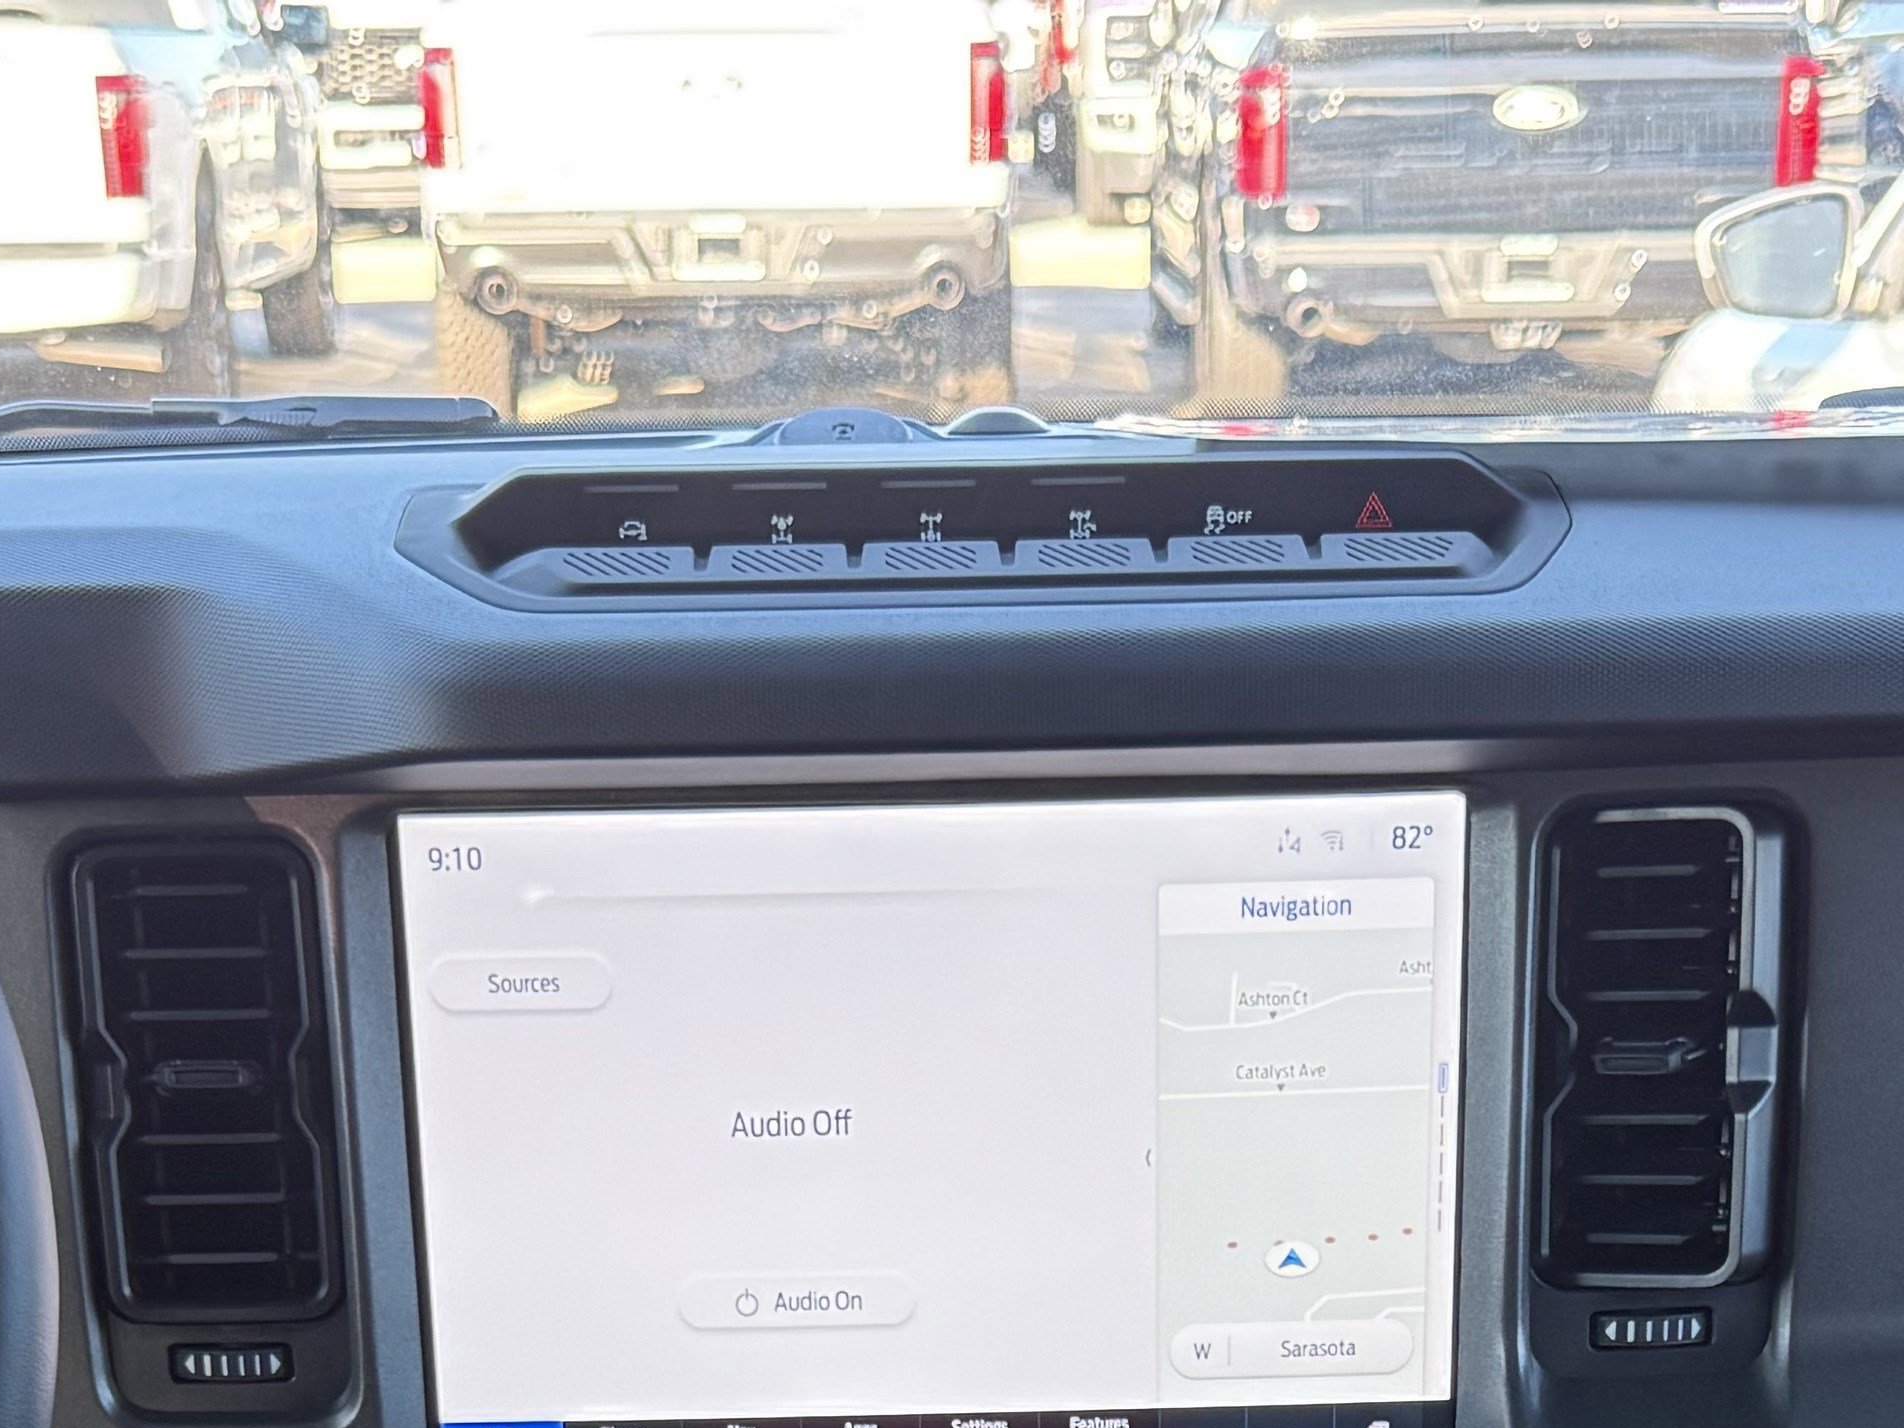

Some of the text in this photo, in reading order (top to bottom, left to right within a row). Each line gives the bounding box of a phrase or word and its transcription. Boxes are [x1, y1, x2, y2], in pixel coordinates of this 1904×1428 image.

[1227, 511, 1252, 523] OFF
[1393, 826, 1433, 849] 82°
[429, 847, 481, 871] 9:10
[1242, 896, 1351, 921] Navigation
[488, 974, 559, 993] Sources
[1238, 989, 1308, 1007] Ashton Ct
[1235, 1063, 1326, 1082] Catalyst Ave
[732, 1109, 851, 1137] Audio Off
[775, 1291, 862, 1311] Audio On
[1194, 1341, 1355, 1359] W Sarasota
